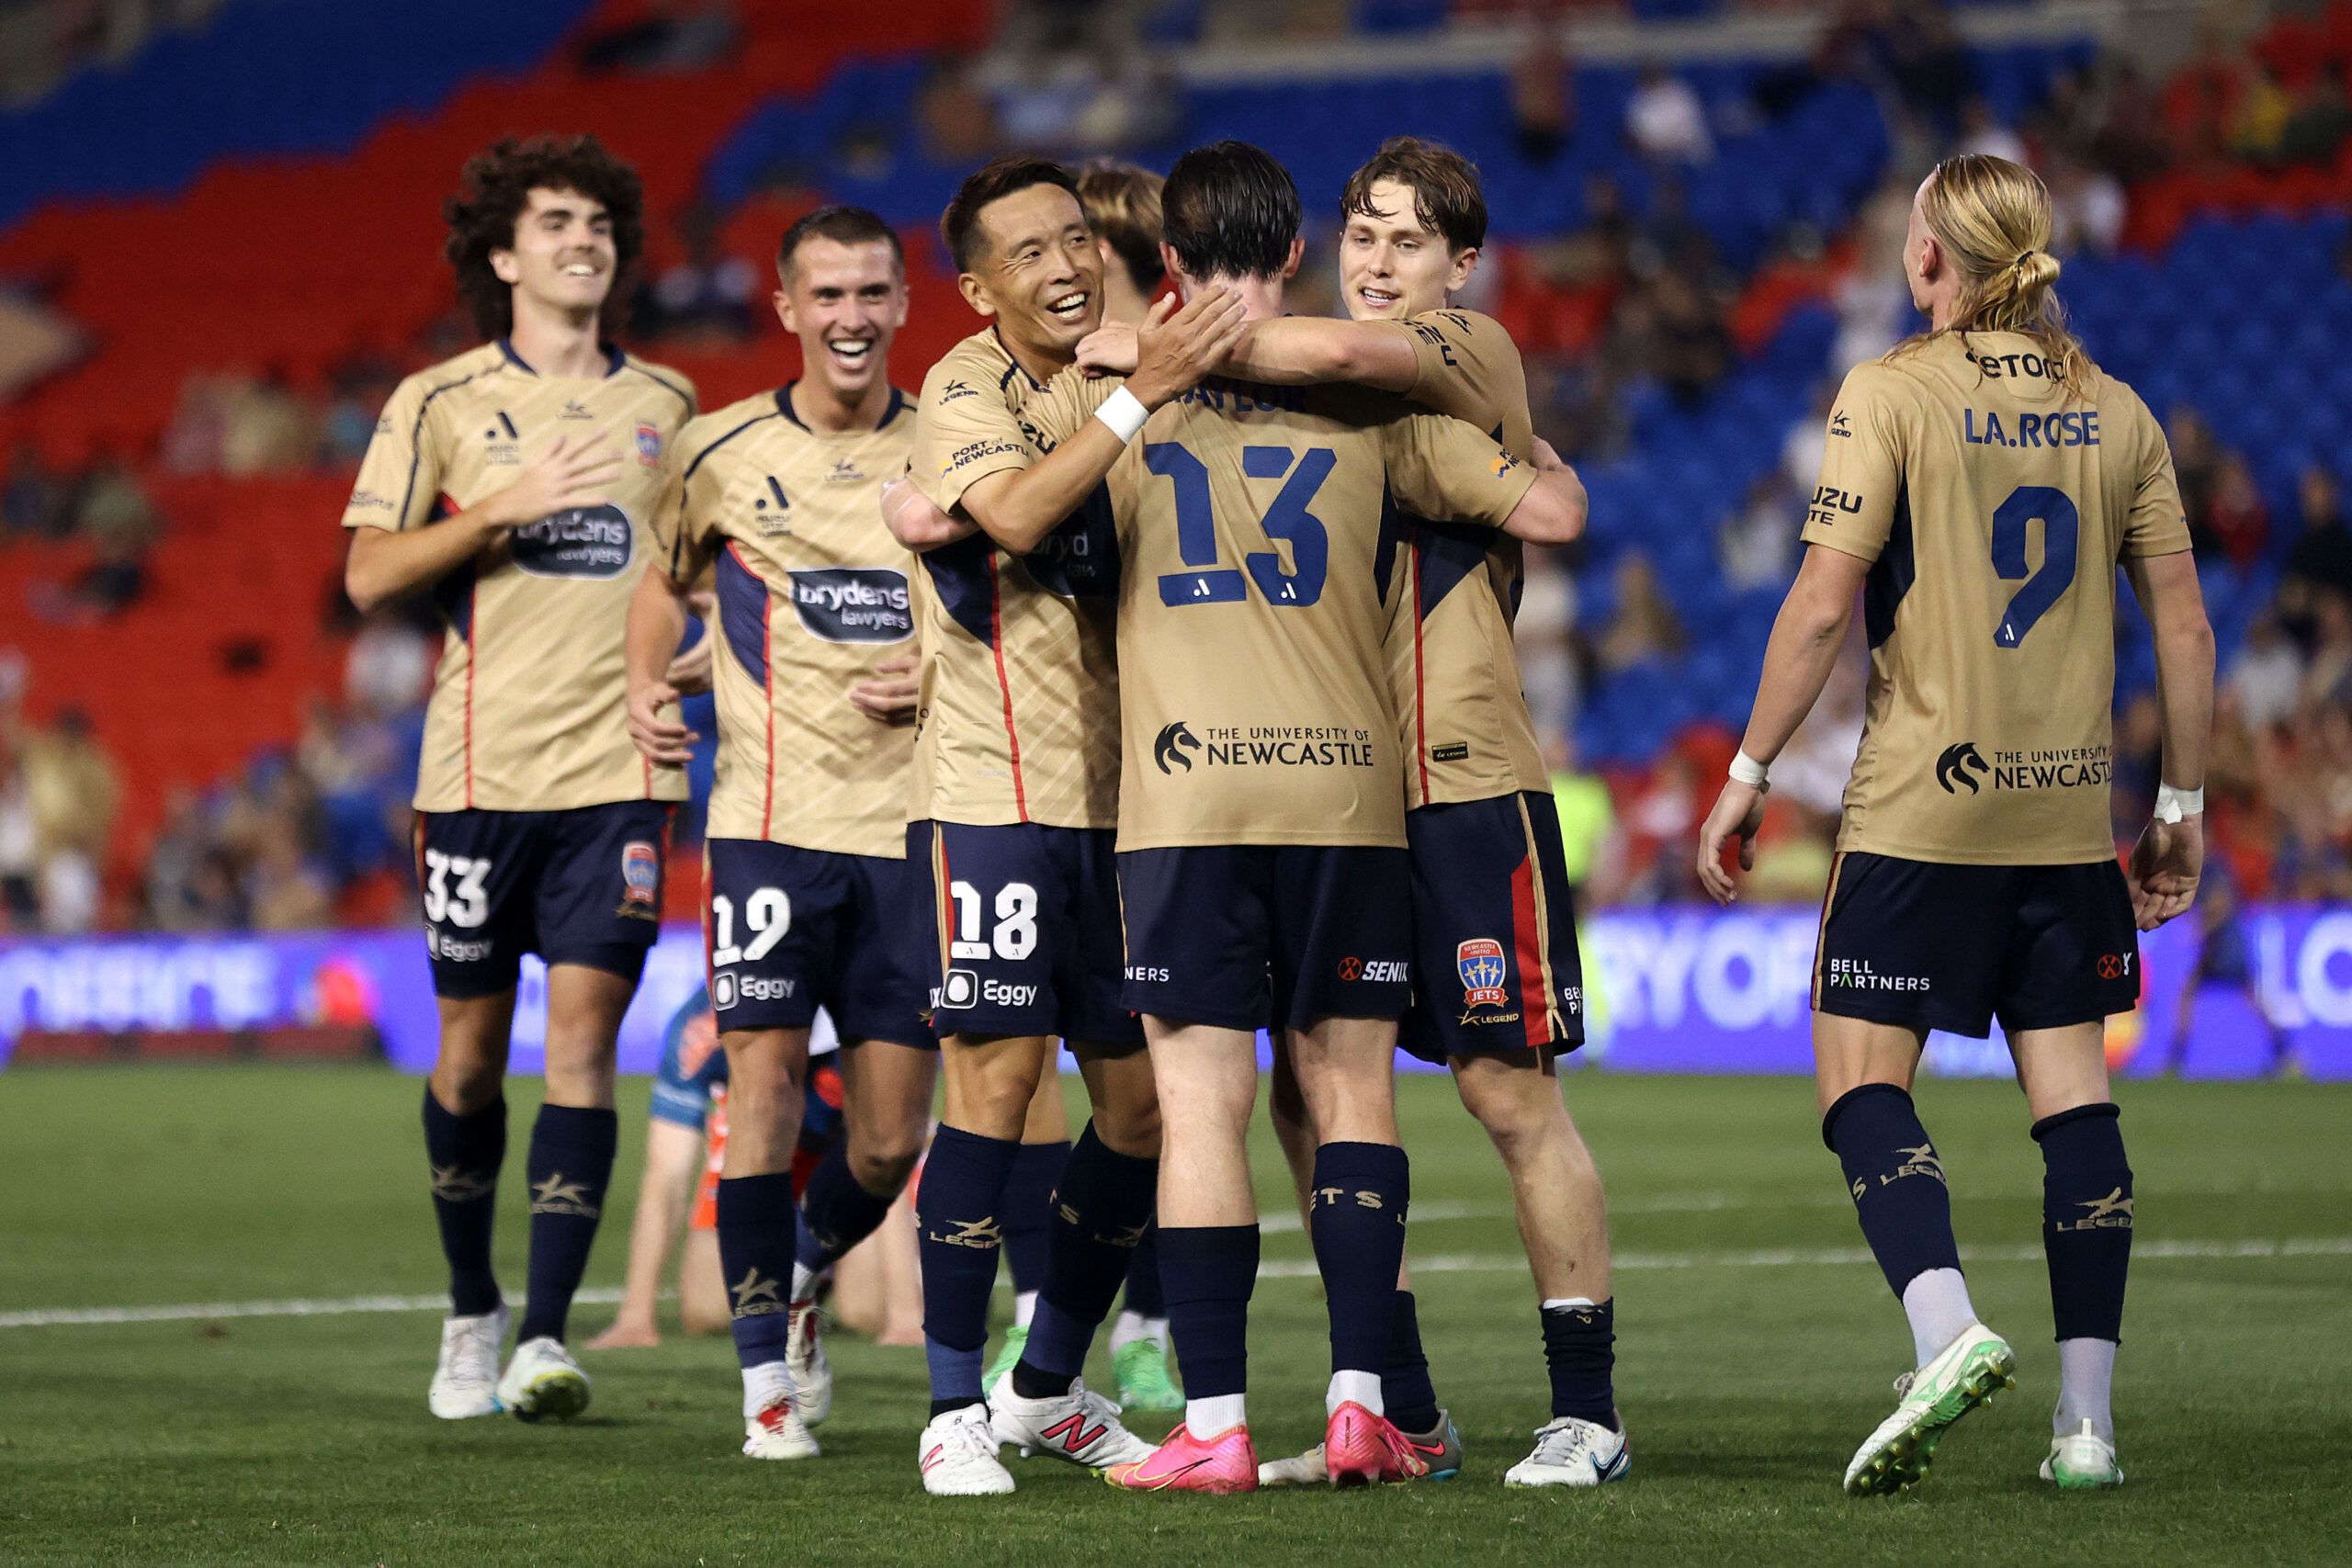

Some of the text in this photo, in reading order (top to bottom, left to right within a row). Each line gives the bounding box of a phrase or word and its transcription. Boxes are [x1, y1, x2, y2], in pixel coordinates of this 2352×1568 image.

[1964, 408, 2100, 448] LA.ROSE
[952, 441, 988, 461] PORT
[1145, 442, 1338, 607] 13
[1992, 486, 2078, 649] 9
[799, 580, 909, 611] brydens
[842, 608, 909, 630] lawyers
[1207, 728, 1369, 740] THE UNIVERSITY OF
[1208, 742, 1374, 766] NEWCASTLE
[1995, 751, 2022, 763] THE
[2031, 746, 2107, 762] UNIVERSITY
[424, 848, 492, 928] 33
[712, 887, 791, 967] 19
[951, 882, 1038, 960] 18
[1831, 958, 1872, 974] BELL
[741, 976, 796, 1001] Eggy
[984, 979, 1037, 1006] Eggy
[1830, 974, 1930, 990] PARTNERS
[1471, 989, 1499, 1002] JETS
[1481, 1013, 1520, 1024] LEGEND
